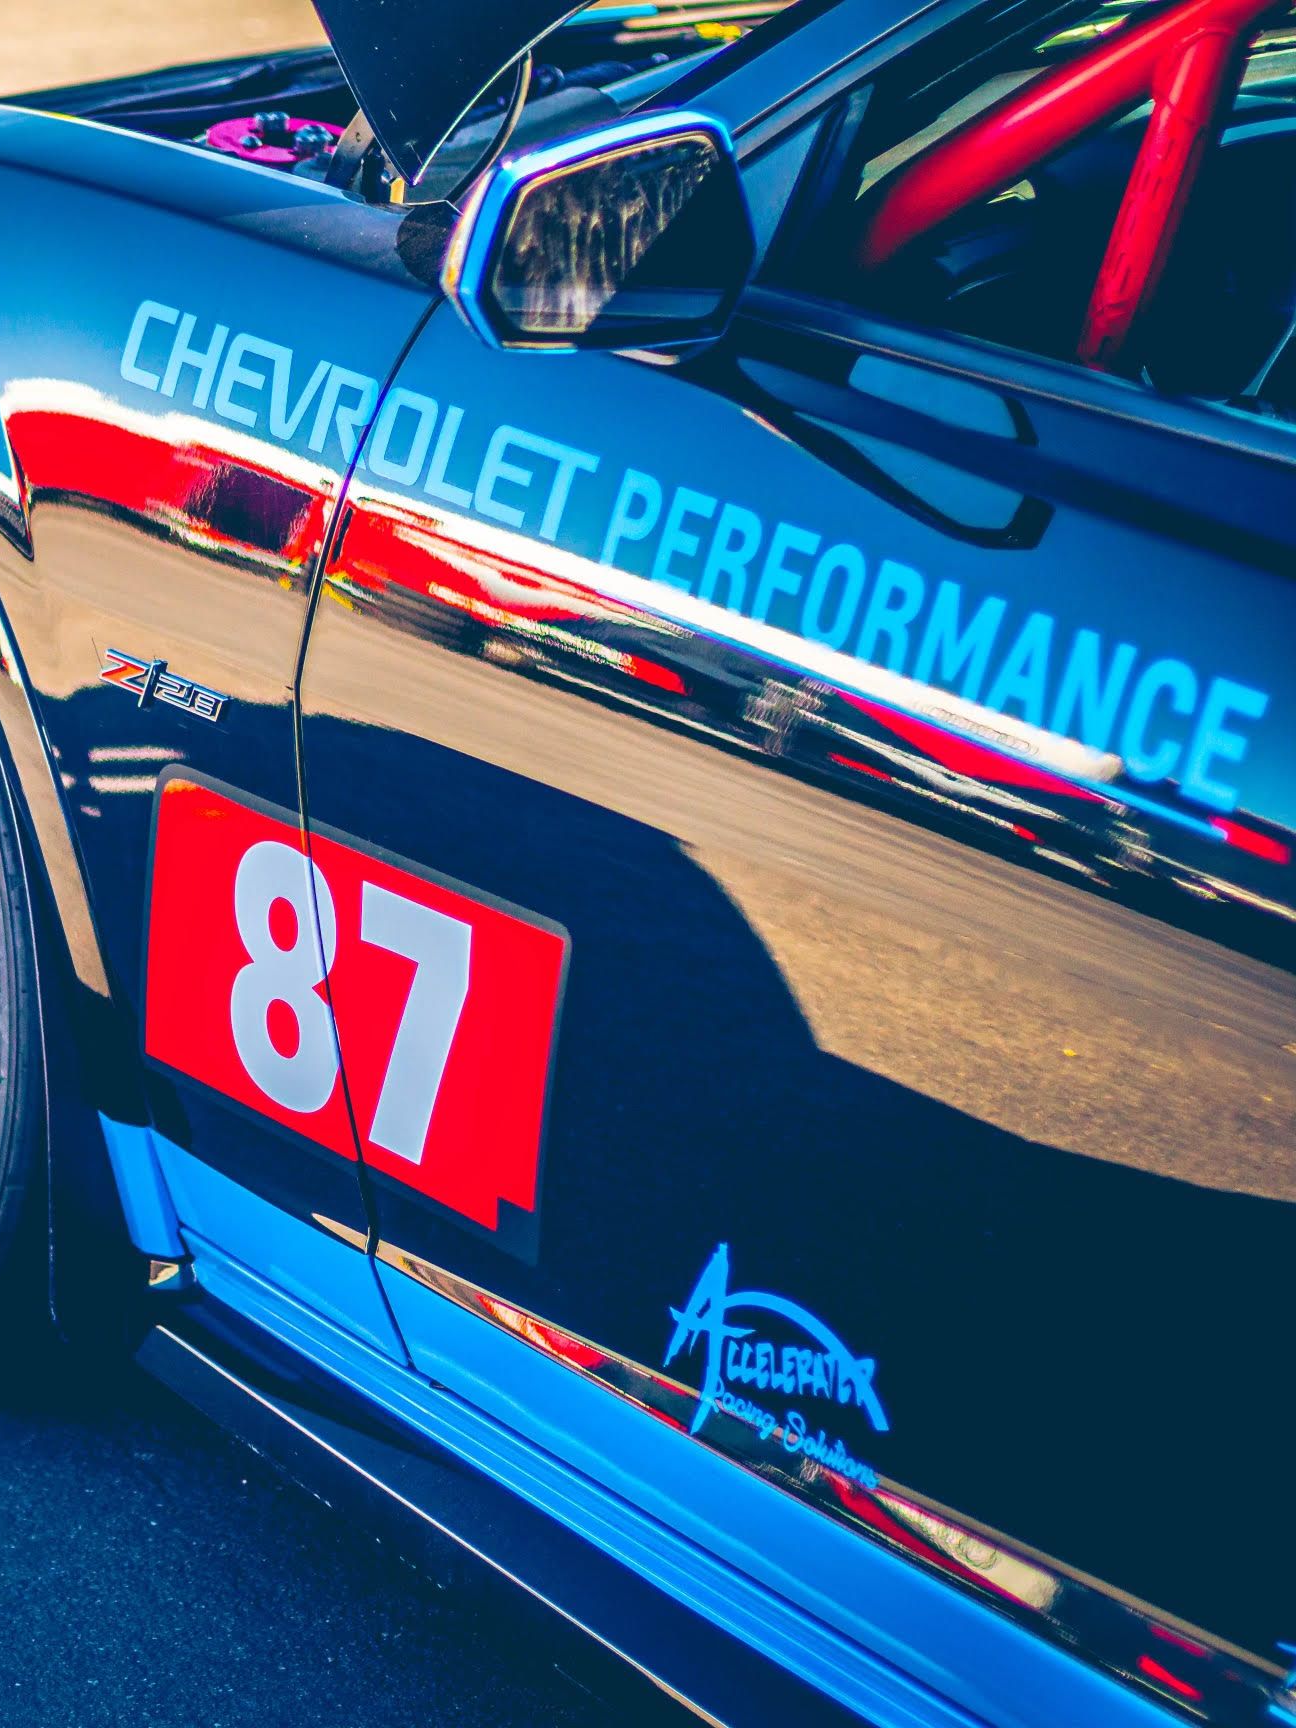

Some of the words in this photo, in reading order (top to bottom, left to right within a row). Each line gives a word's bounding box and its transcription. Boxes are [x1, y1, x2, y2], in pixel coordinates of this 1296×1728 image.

[120, 299, 601, 541] CHEVROLET
[598, 467, 1270, 813] PERFORMANCE
[231, 840, 472, 1166] 87
